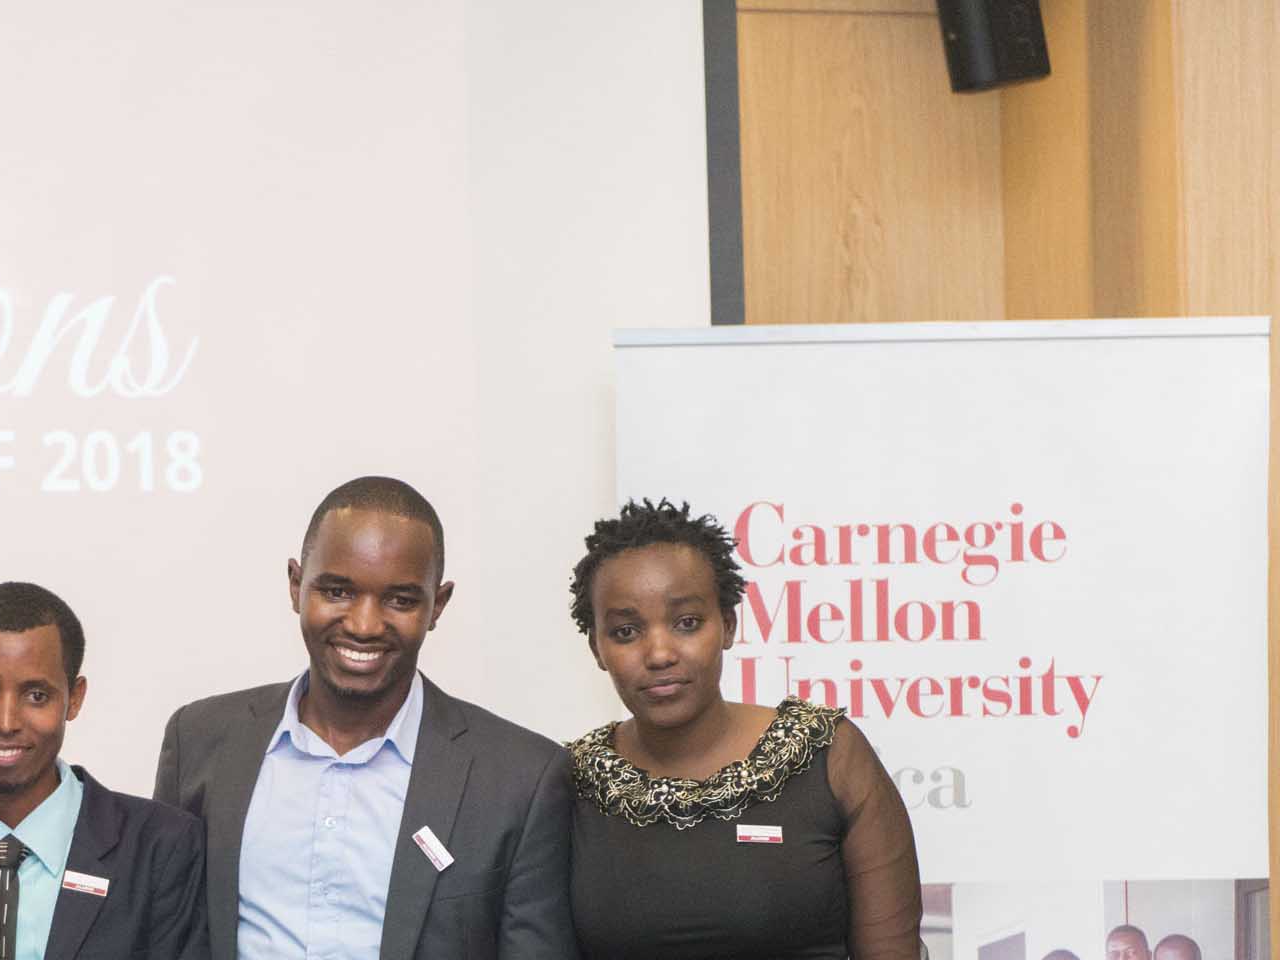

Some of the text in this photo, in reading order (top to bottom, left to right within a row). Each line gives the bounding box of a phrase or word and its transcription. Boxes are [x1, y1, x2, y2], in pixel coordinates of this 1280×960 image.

[40, 427, 204, 494] 2018
[732, 500, 1067, 587] Carnegie
[735, 577, 987, 646] Mellon
[735, 655, 1104, 740] University
